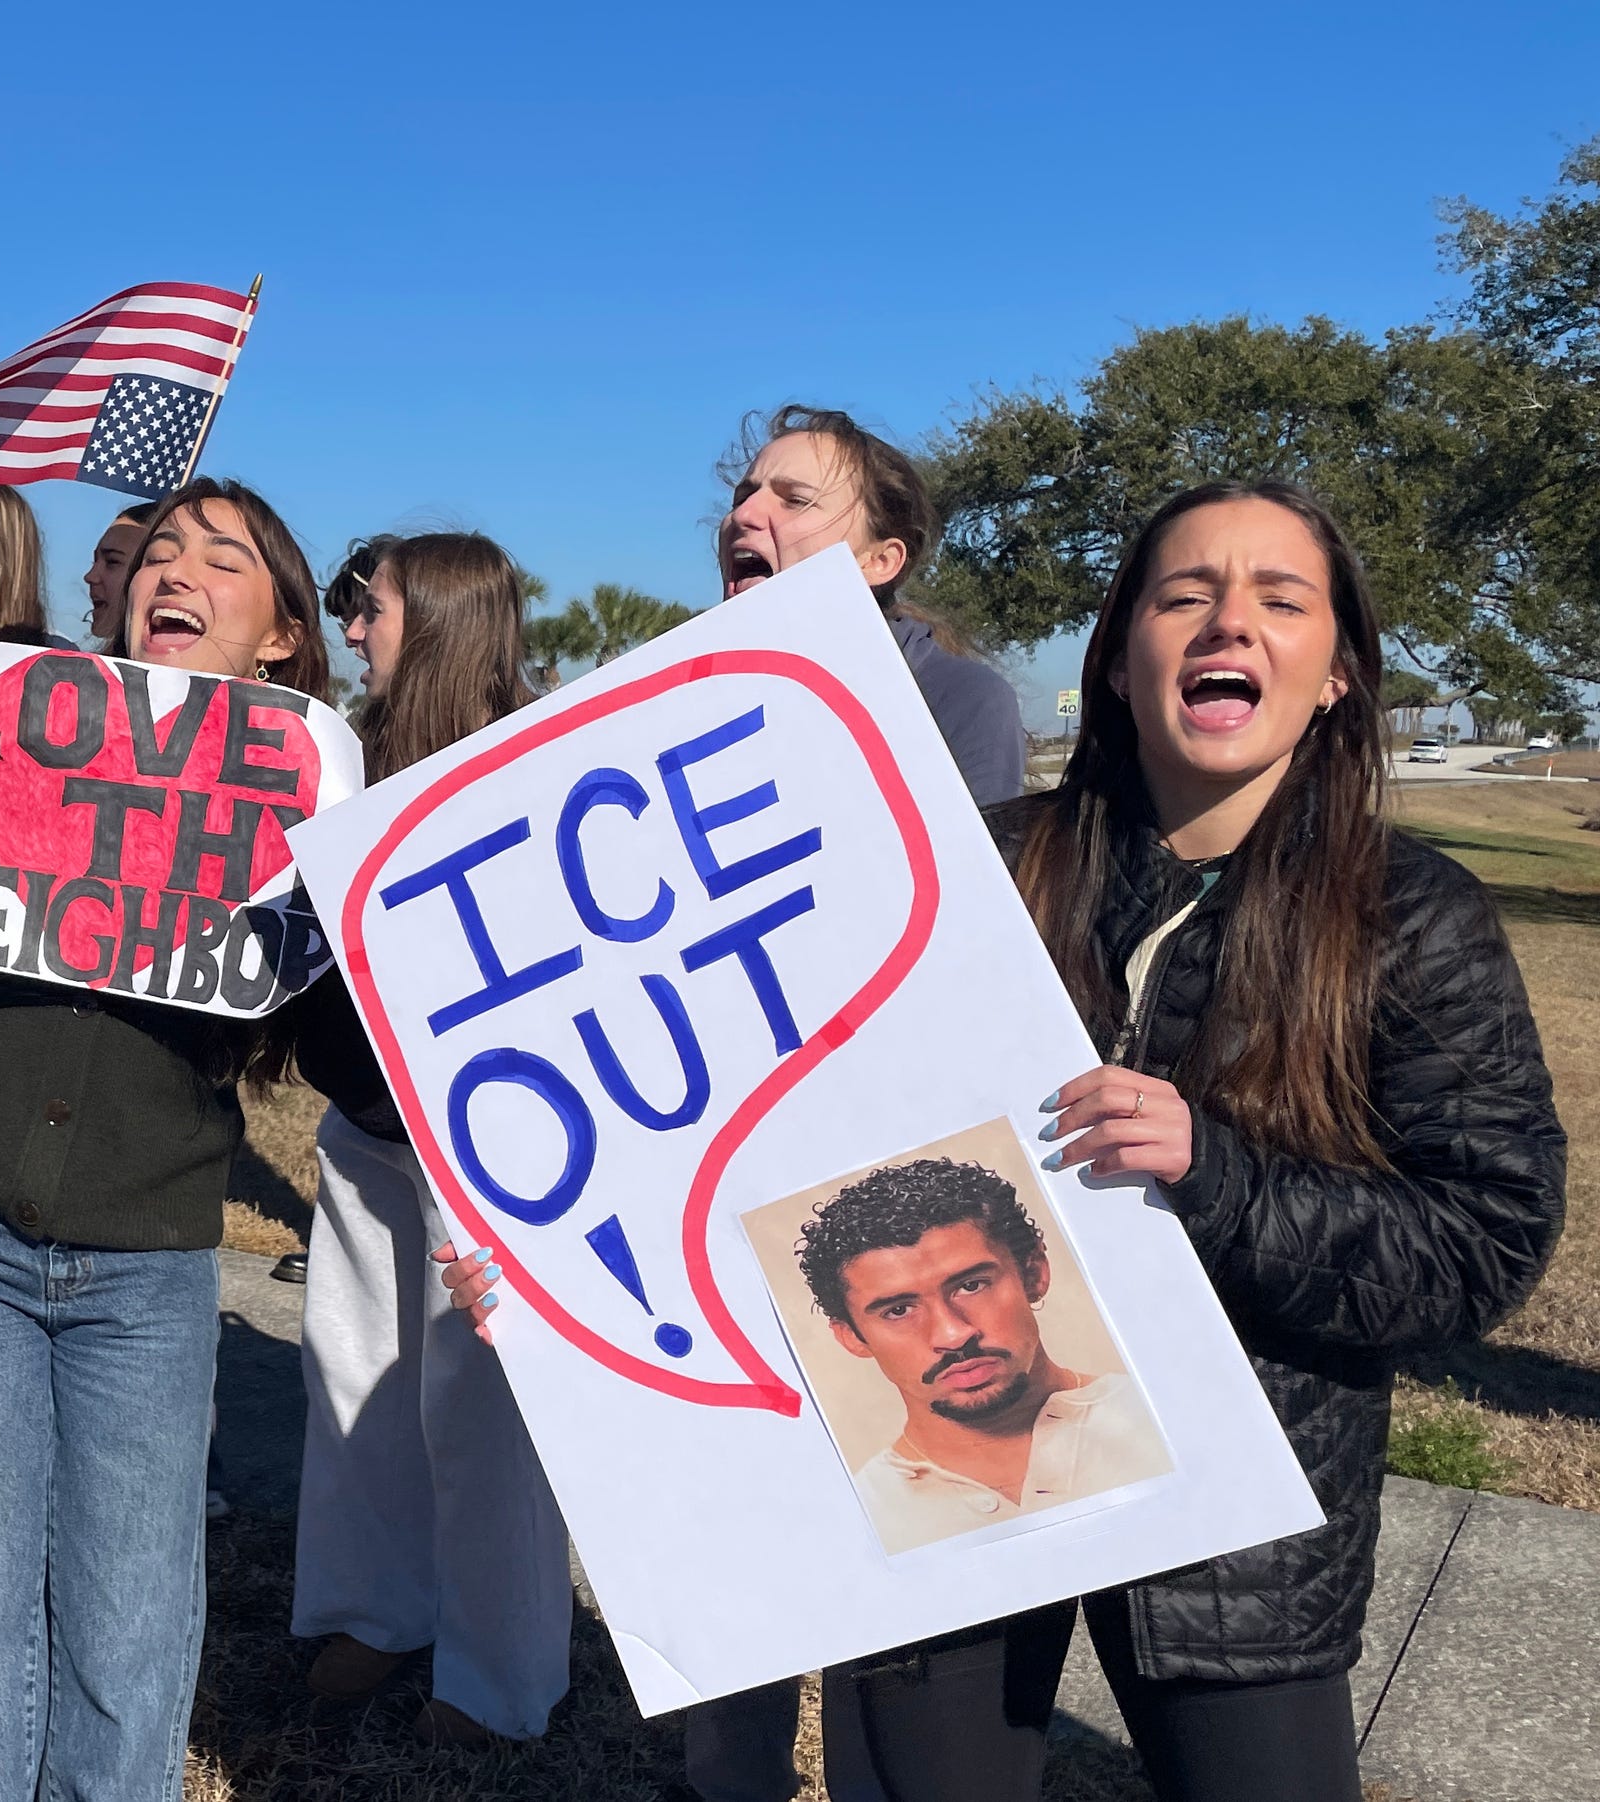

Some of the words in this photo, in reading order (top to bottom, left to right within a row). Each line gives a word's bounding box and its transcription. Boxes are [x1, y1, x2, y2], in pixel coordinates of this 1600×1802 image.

[377, 704, 822, 1037] ICE
[1059, 704, 1077, 714] 40
[446, 884, 818, 1227] OUT
